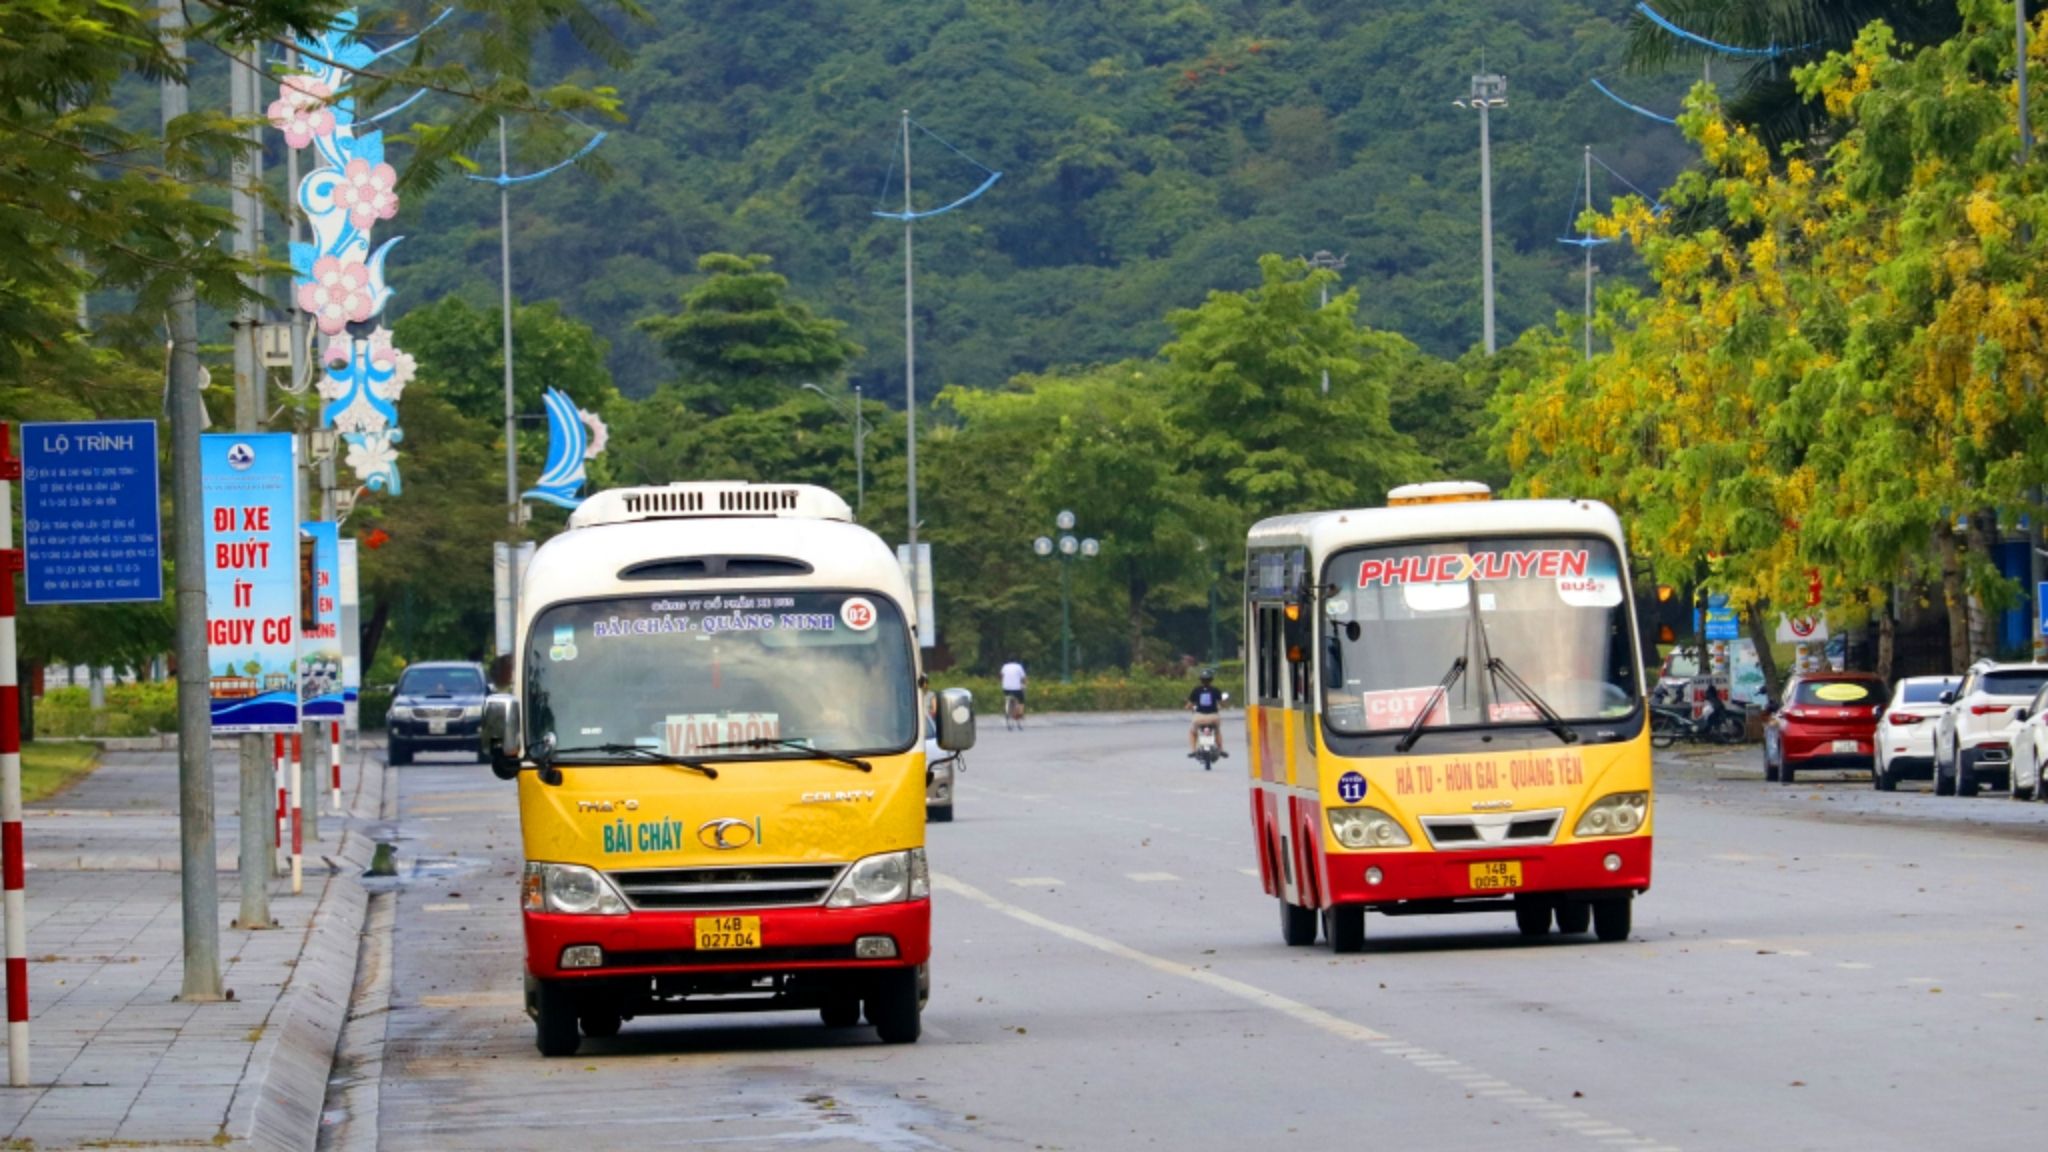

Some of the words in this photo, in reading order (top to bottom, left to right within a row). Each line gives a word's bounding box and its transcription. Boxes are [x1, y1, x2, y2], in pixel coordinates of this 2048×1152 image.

[43, 434, 69, 455] LỘ
[74, 431, 133, 452] TRÌNH
[214, 507, 236, 532] ĐI
[243, 507, 271, 532] XE
[216, 537, 270, 569] BUÝT
[234, 577, 253, 608] ÍT
[593, 616, 630, 637] BÃI
[631, 612, 690, 635] CHÁY
[702, 610, 774, 635] QUẢNG
[780, 613, 835, 632] NINH
[849, 606, 869, 623] 02
[263, 616, 292, 645] CƠ
[1396, 762, 1415, 795] HÀ
[1416, 766, 1434, 793] TU
[1445, 759, 1473, 792] HÒN
[1475, 761, 1499, 790] GAI
[1510, 756, 1554, 791] QUẢNG
[801, 789, 876, 803] COUNTY
[1342, 784, 1361, 800] 11
[603, 818, 633, 853] BÃI
[638, 816, 683, 852] CHÁY
[1485, 863, 1507, 875] 14B
[715, 917, 742, 932] 14B
[701, 932, 754, 949] 027.04
